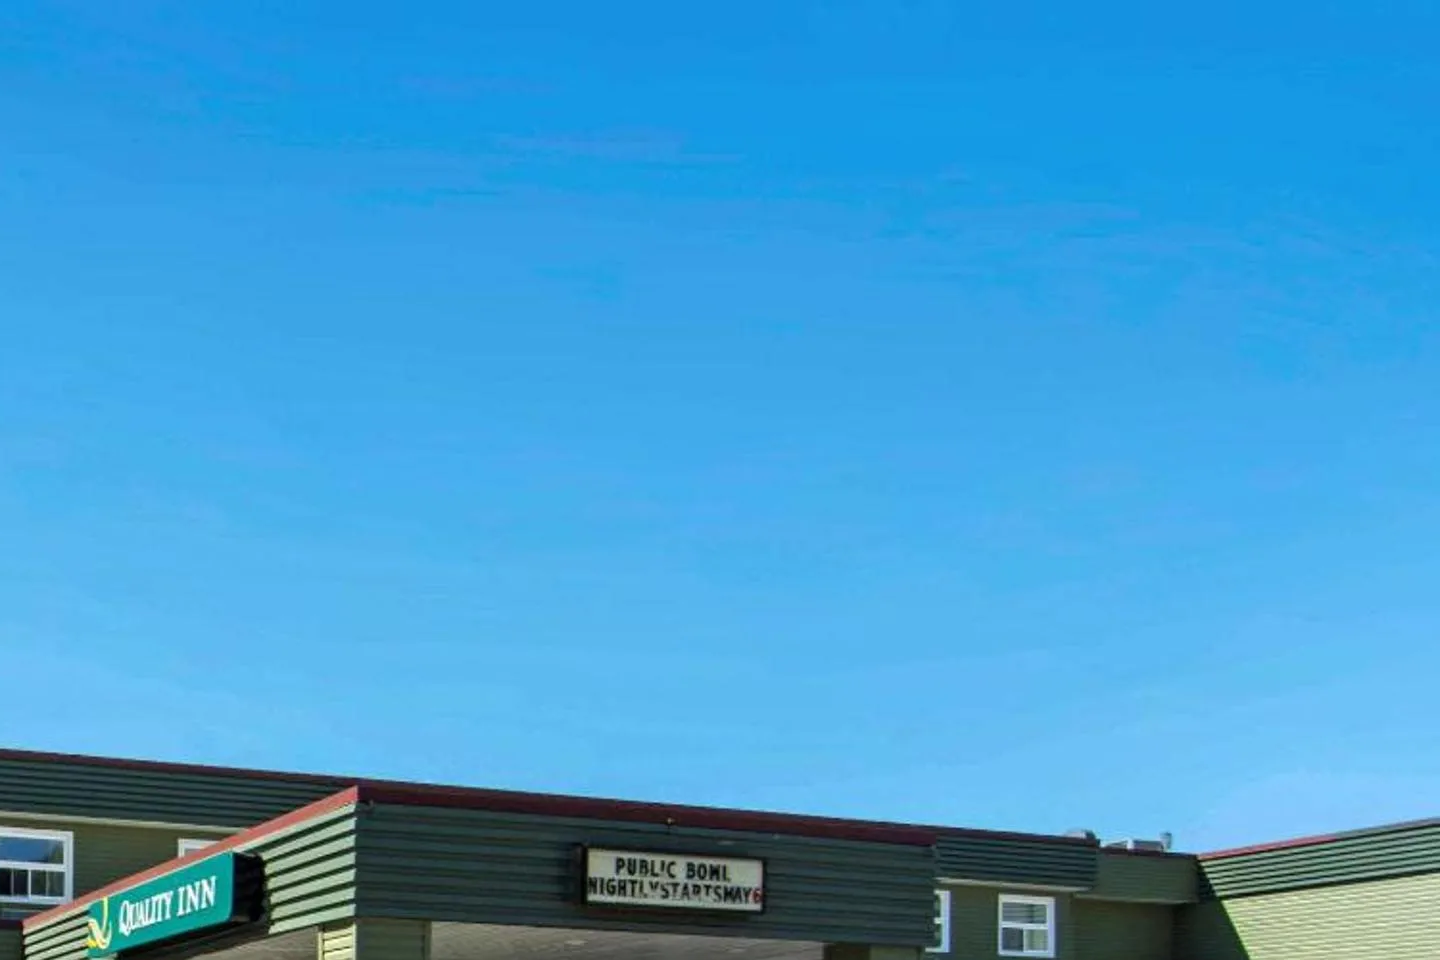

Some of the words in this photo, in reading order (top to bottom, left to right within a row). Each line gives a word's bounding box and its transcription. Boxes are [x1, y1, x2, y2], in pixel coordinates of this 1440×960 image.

[615, 857, 677, 879] PUBLIC
[118, 890, 174, 937] QUALITY
[176, 876, 216, 917] INN
